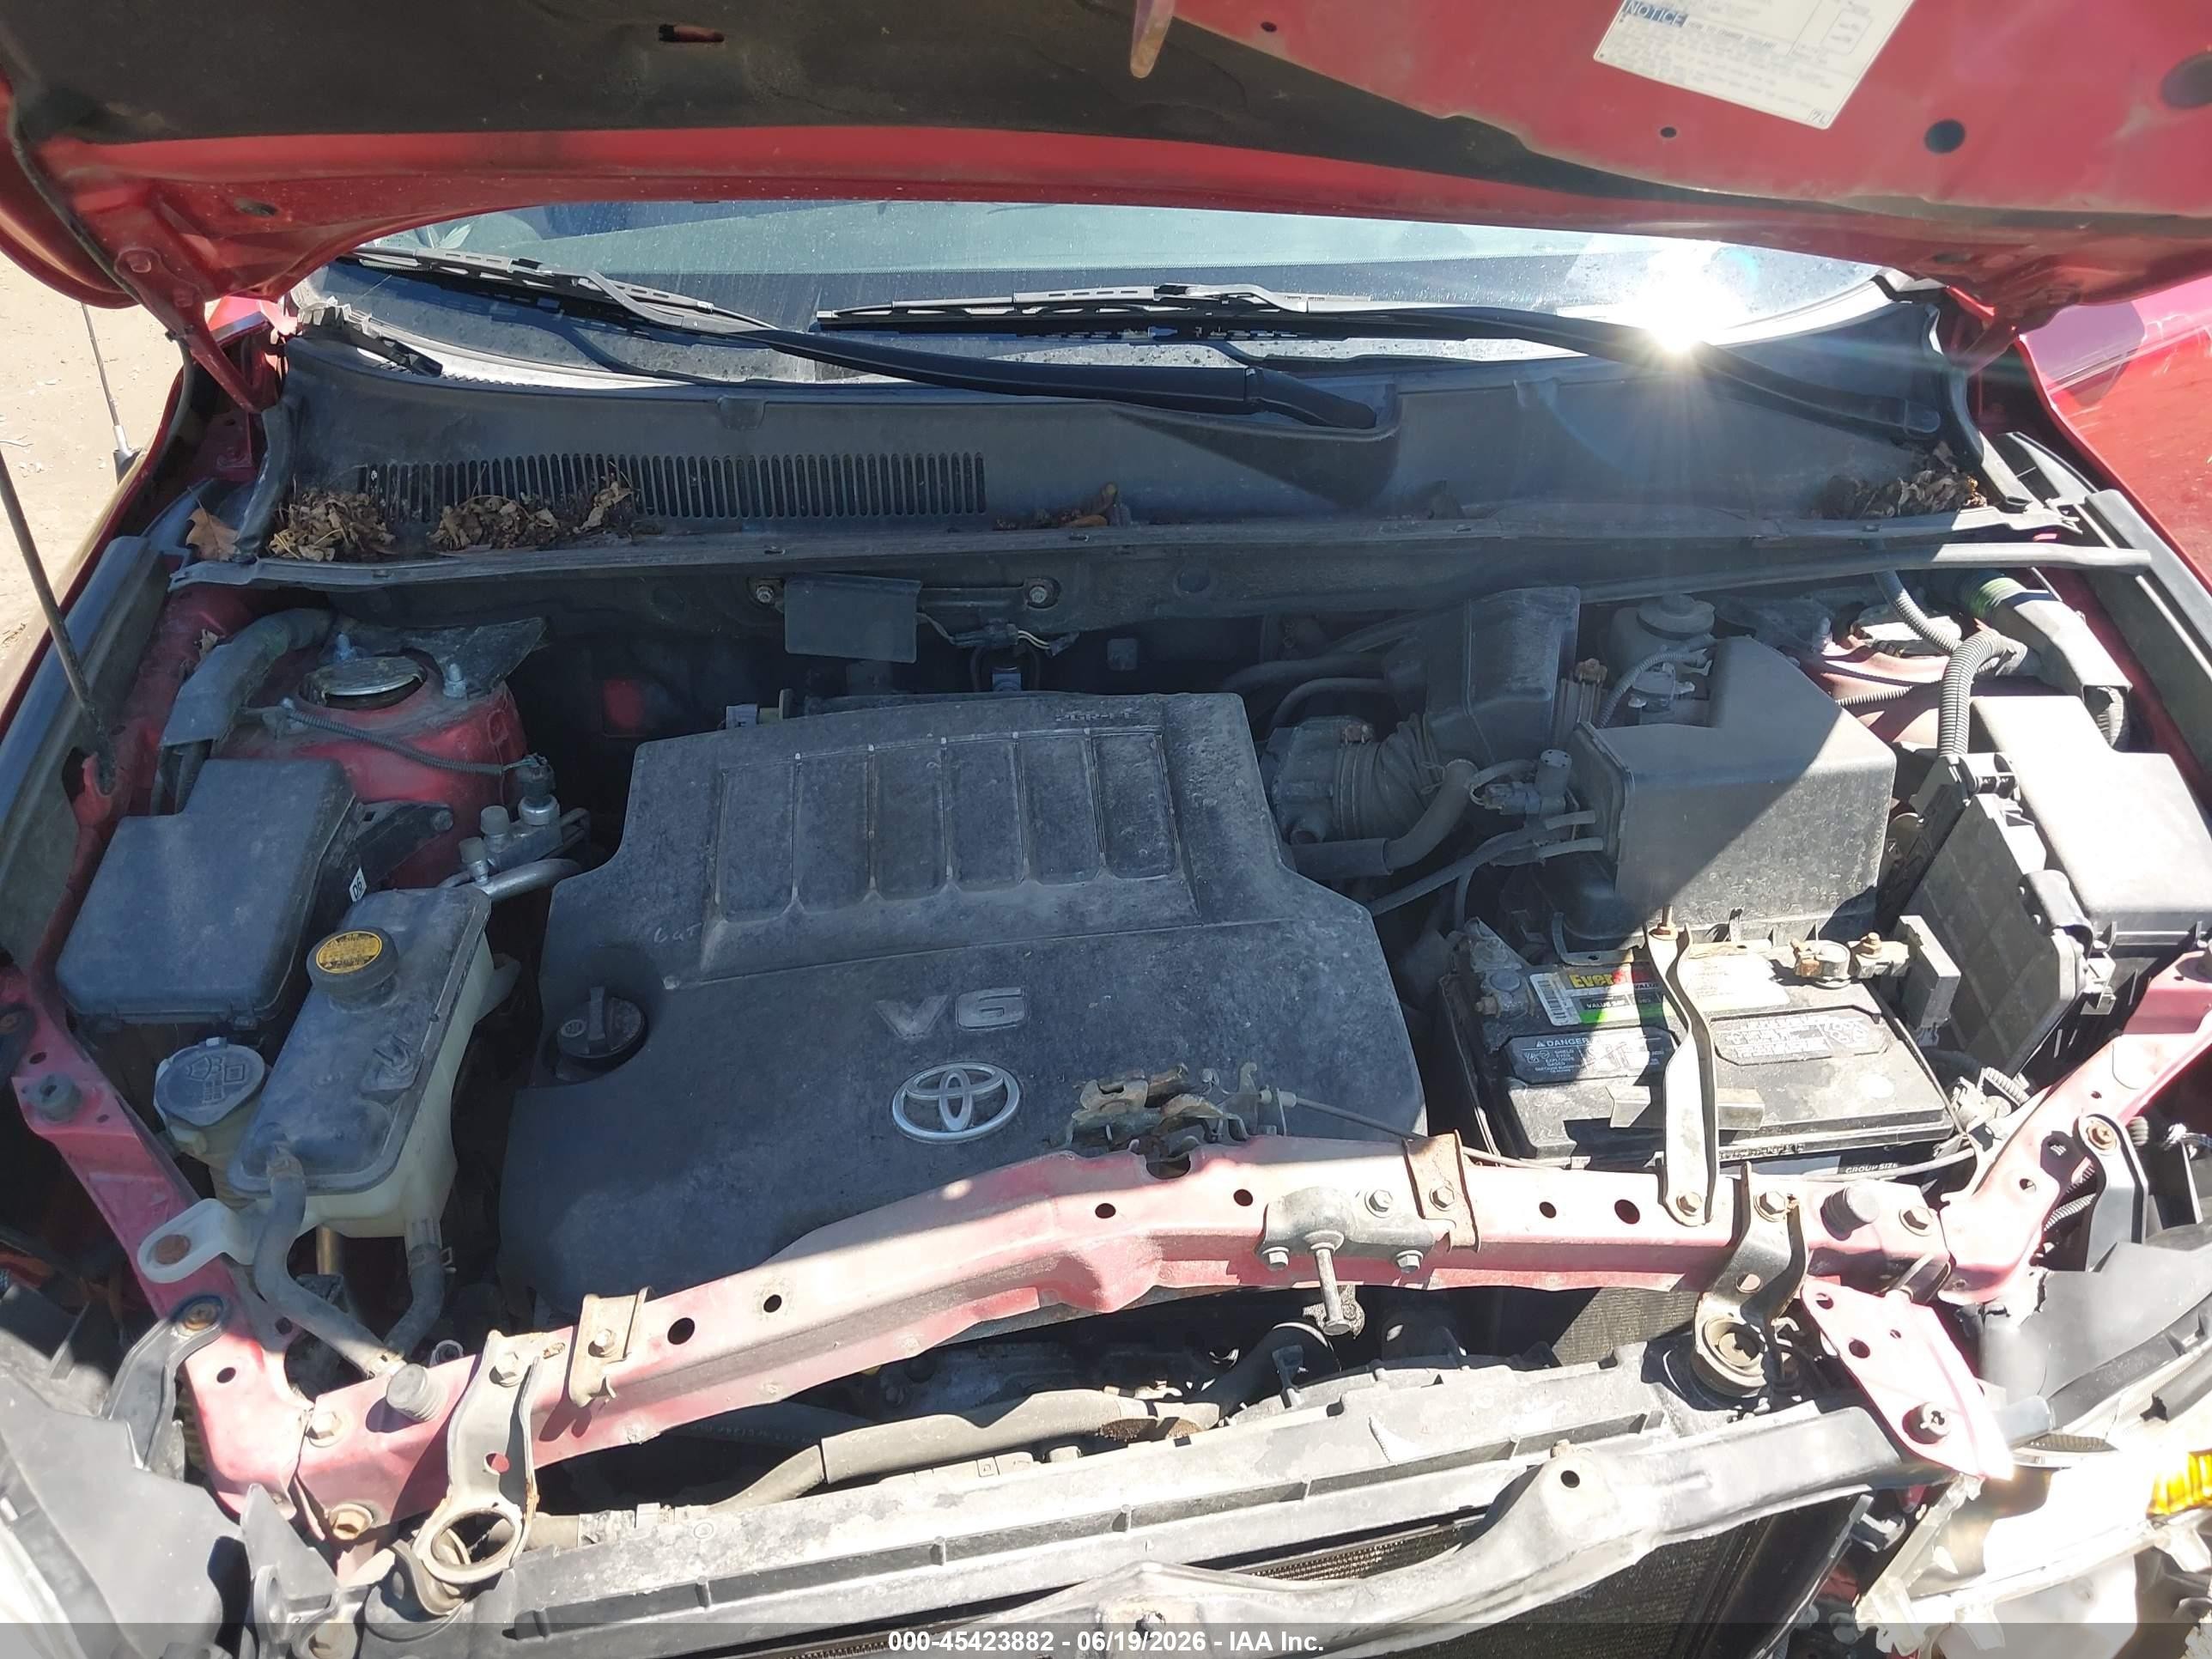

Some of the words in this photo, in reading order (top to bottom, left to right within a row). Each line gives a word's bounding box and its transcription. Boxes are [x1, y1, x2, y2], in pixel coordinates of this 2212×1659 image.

[1626, 0, 1688, 27] NOTICE
[872, 987, 1028, 1038] V6
[1547, 1037, 1589, 1047] DANGER
[1845, 1164, 1879, 1174] GROUP
